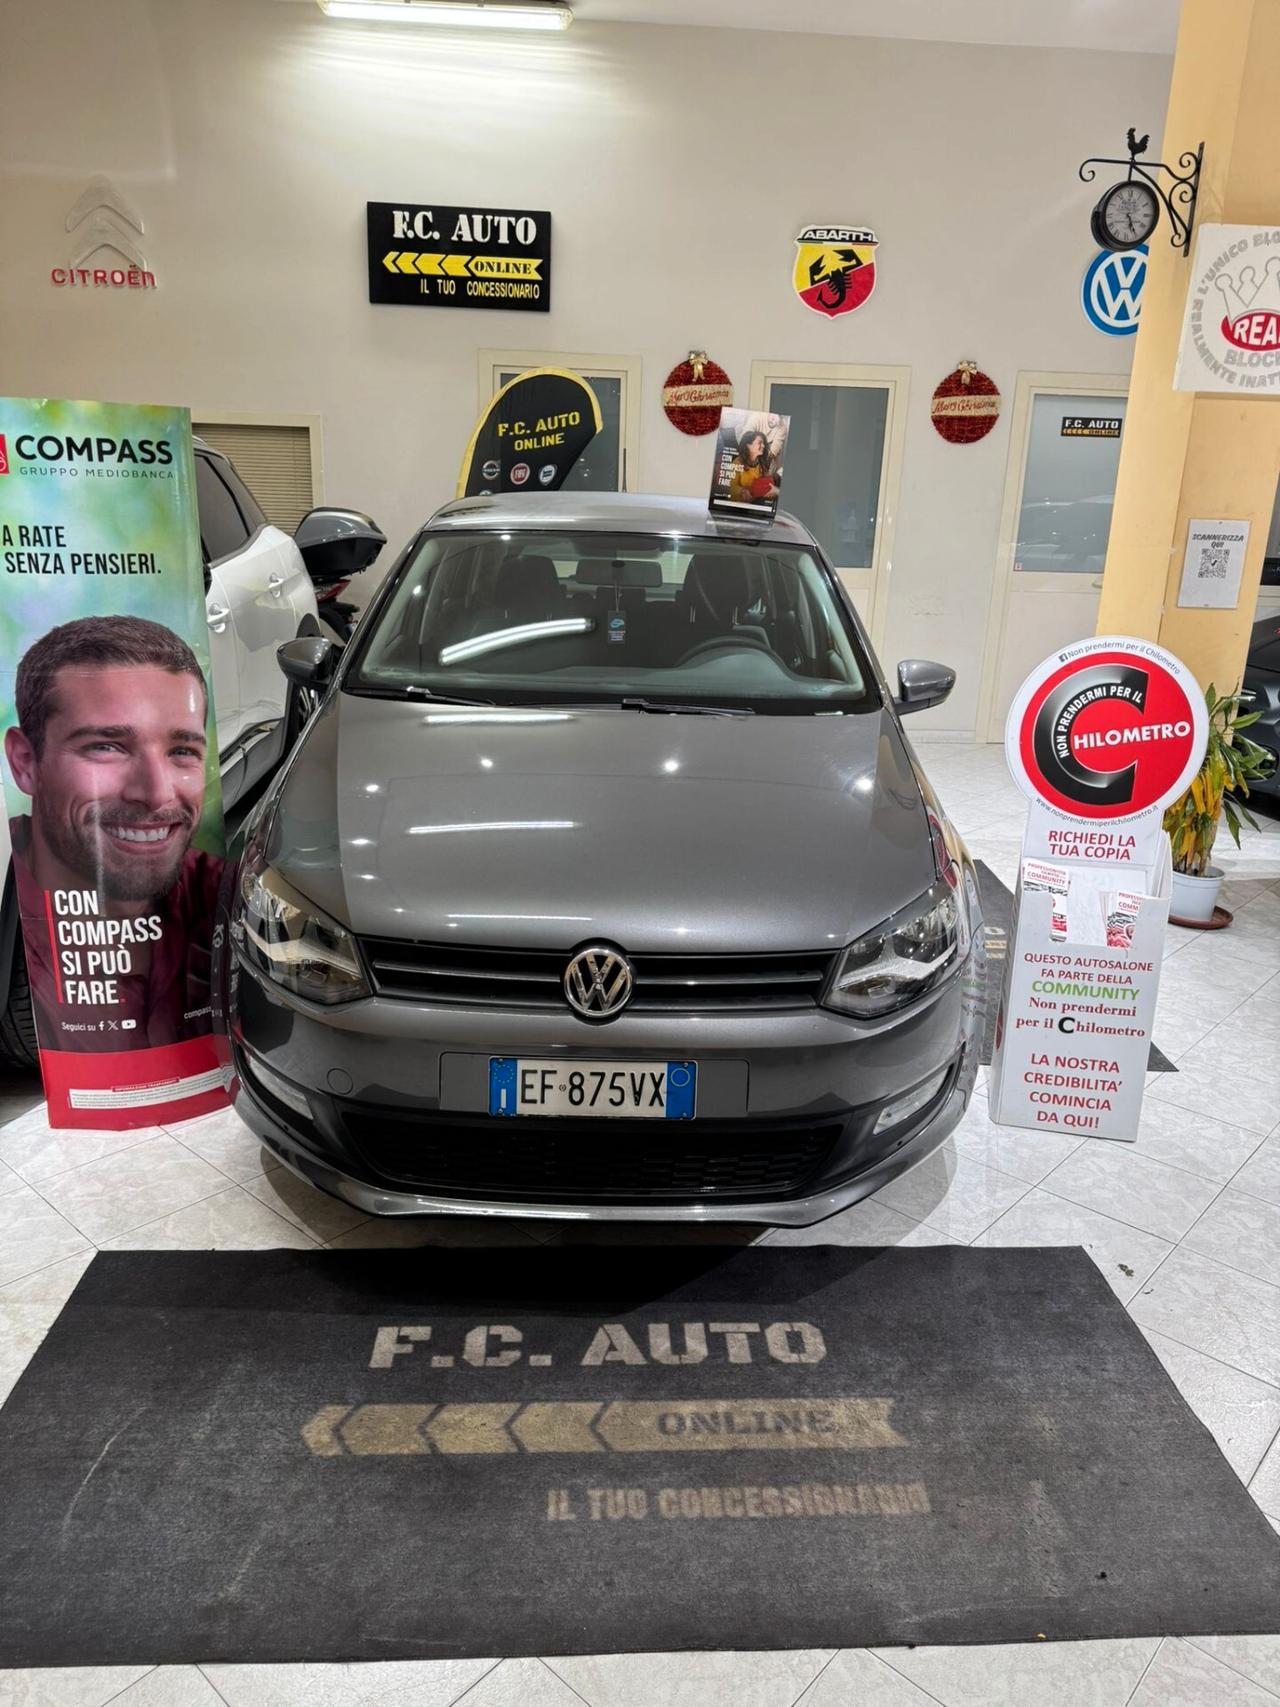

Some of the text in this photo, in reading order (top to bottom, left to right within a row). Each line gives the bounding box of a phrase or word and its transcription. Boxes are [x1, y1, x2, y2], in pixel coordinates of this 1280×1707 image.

[393, 210, 537, 245] F.C. AUTO
[804, 230, 872, 241] ABARTH
[474, 261, 532, 275] ONLINE
[1198, 238, 1248, 295] L'UNICO
[420, 278, 540, 299] IL TUO CONCESSIONARIO
[1233, 314, 1280, 346] REA
[1191, 299, 1238, 384] REALMENTE
[497, 411, 580, 437] F.C. AUTO
[1065, 419, 1119, 429] F.C. AUTO
[15, 435, 173, 465] COMPASS
[514, 433, 565, 451] ONLINE
[19, 466, 174, 480] GRUPPO MEDIOBANCA
[2, 524, 67, 548] A RATE
[1192, 533, 1244, 542] SCANNERIZZA
[4, 552, 162, 575] SENZA PENSIERI.
[1067, 648, 1084, 659] Non
[1085, 641, 1125, 652] prendermi
[1126, 642, 1139, 651] per
[1145, 647, 1181, 675] Chilometro
[1056, 685, 1143, 759] NON PRENDERMI PER IL
[1049, 830, 1136, 848] RICHIEDI LA
[1049, 843, 1131, 860] TUA COPIA
[1027, 871, 1066, 884] COMMUNITY
[54, 889, 99, 916] CON
[58, 915, 163, 946] COMPASS
[61, 945, 132, 976] SI PUÒ
[1024, 952, 1153, 972] QUESTO AUTOSALONE
[1041, 968, 1132, 985] FA PARTE DELLA
[1032, 981, 1140, 1001] COMMUNITY
[1029, 997, 1137, 1018] Non prendermi
[61, 1021, 96, 1031] Seguici su
[1016, 1016, 1145, 1038] per il Chilometro
[1031, 1053, 1119, 1073] LA NOSTRA
[1024, 1072, 1122, 1093] CREDIBILITA'
[1029, 1091, 1111, 1111] COMINCIA
[1037, 1110, 1099, 1128] DA QUI!
[368, 1321, 828, 1368] F.C. AUTO
[657, 1410, 834, 1438] ONLINE
[546, 1488, 576, 1522] IL
[586, 1487, 648, 1521] TUO
